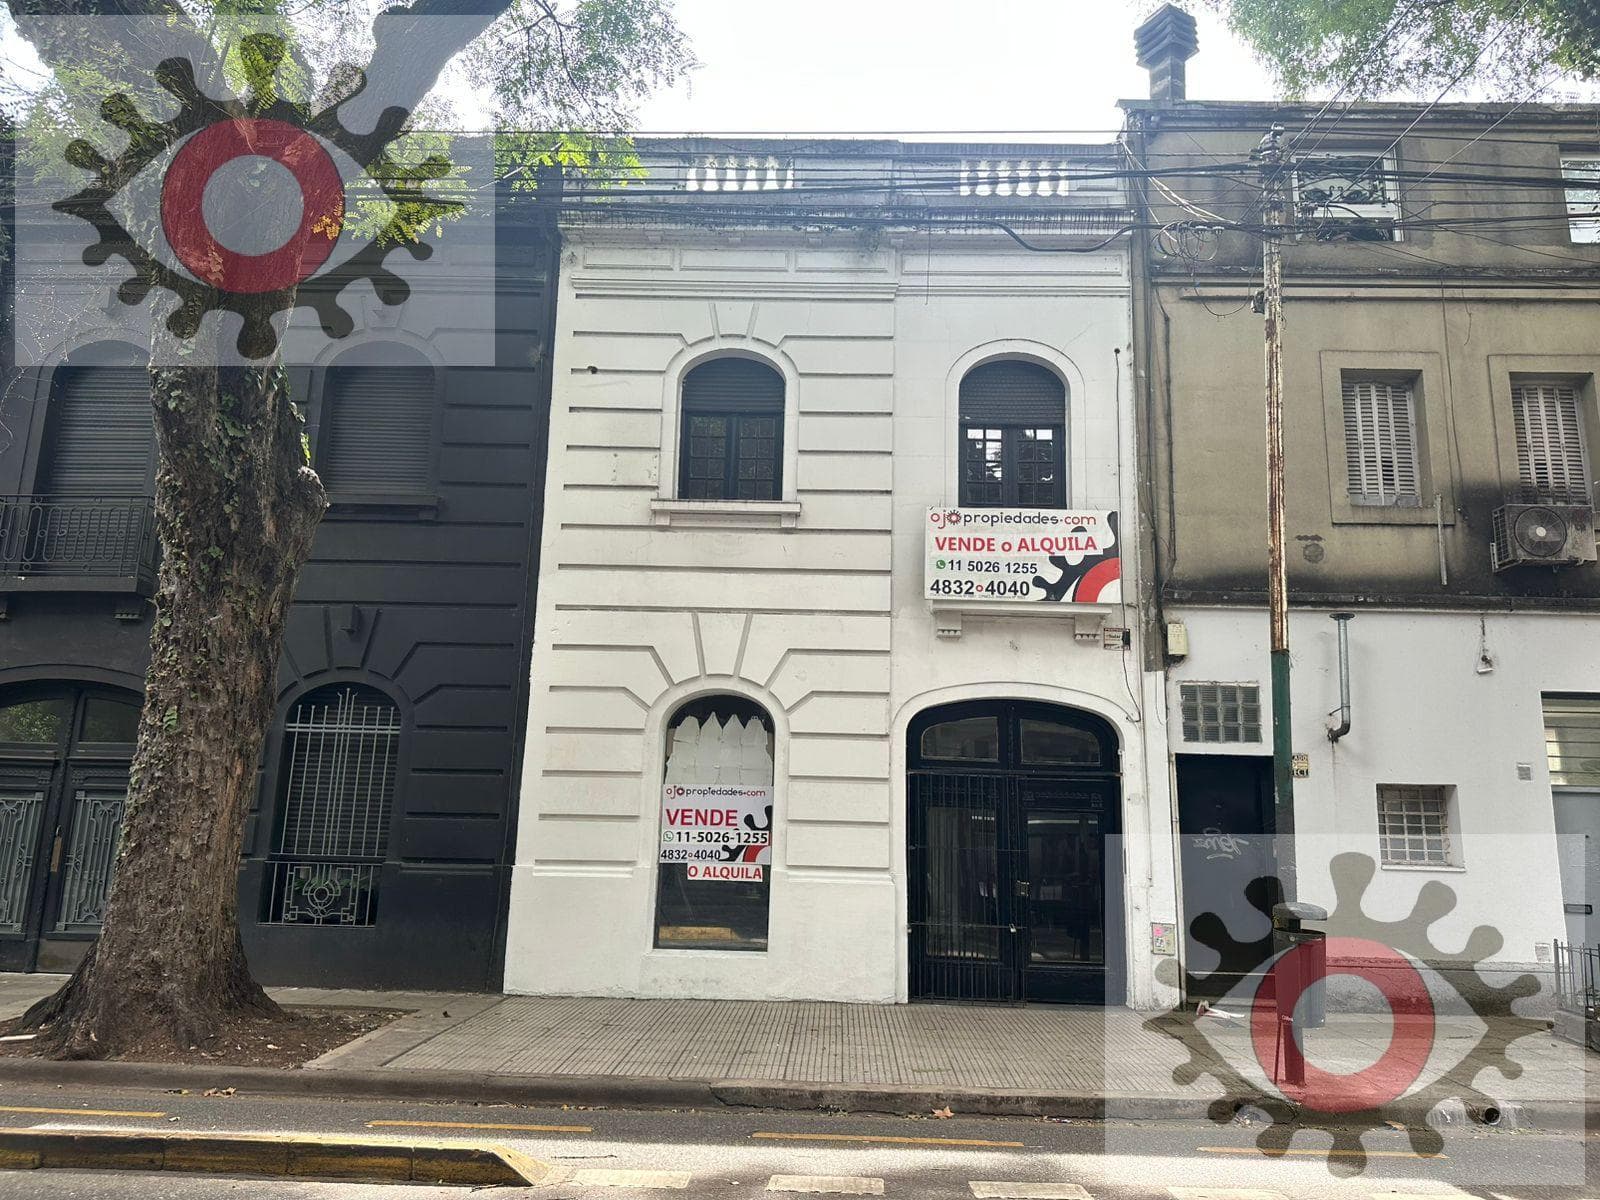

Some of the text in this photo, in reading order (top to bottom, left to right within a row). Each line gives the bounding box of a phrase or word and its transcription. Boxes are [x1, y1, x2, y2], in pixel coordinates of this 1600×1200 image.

[935, 536, 995, 552] VENDE
[1017, 536, 1098, 555] ALQUILA
[948, 559, 1038, 574] 11 5026 1255
[665, 808, 738, 827] VENDE
[676, 831, 768, 843] 11-5026-1255
[688, 865, 762, 879] O ALQUILA
